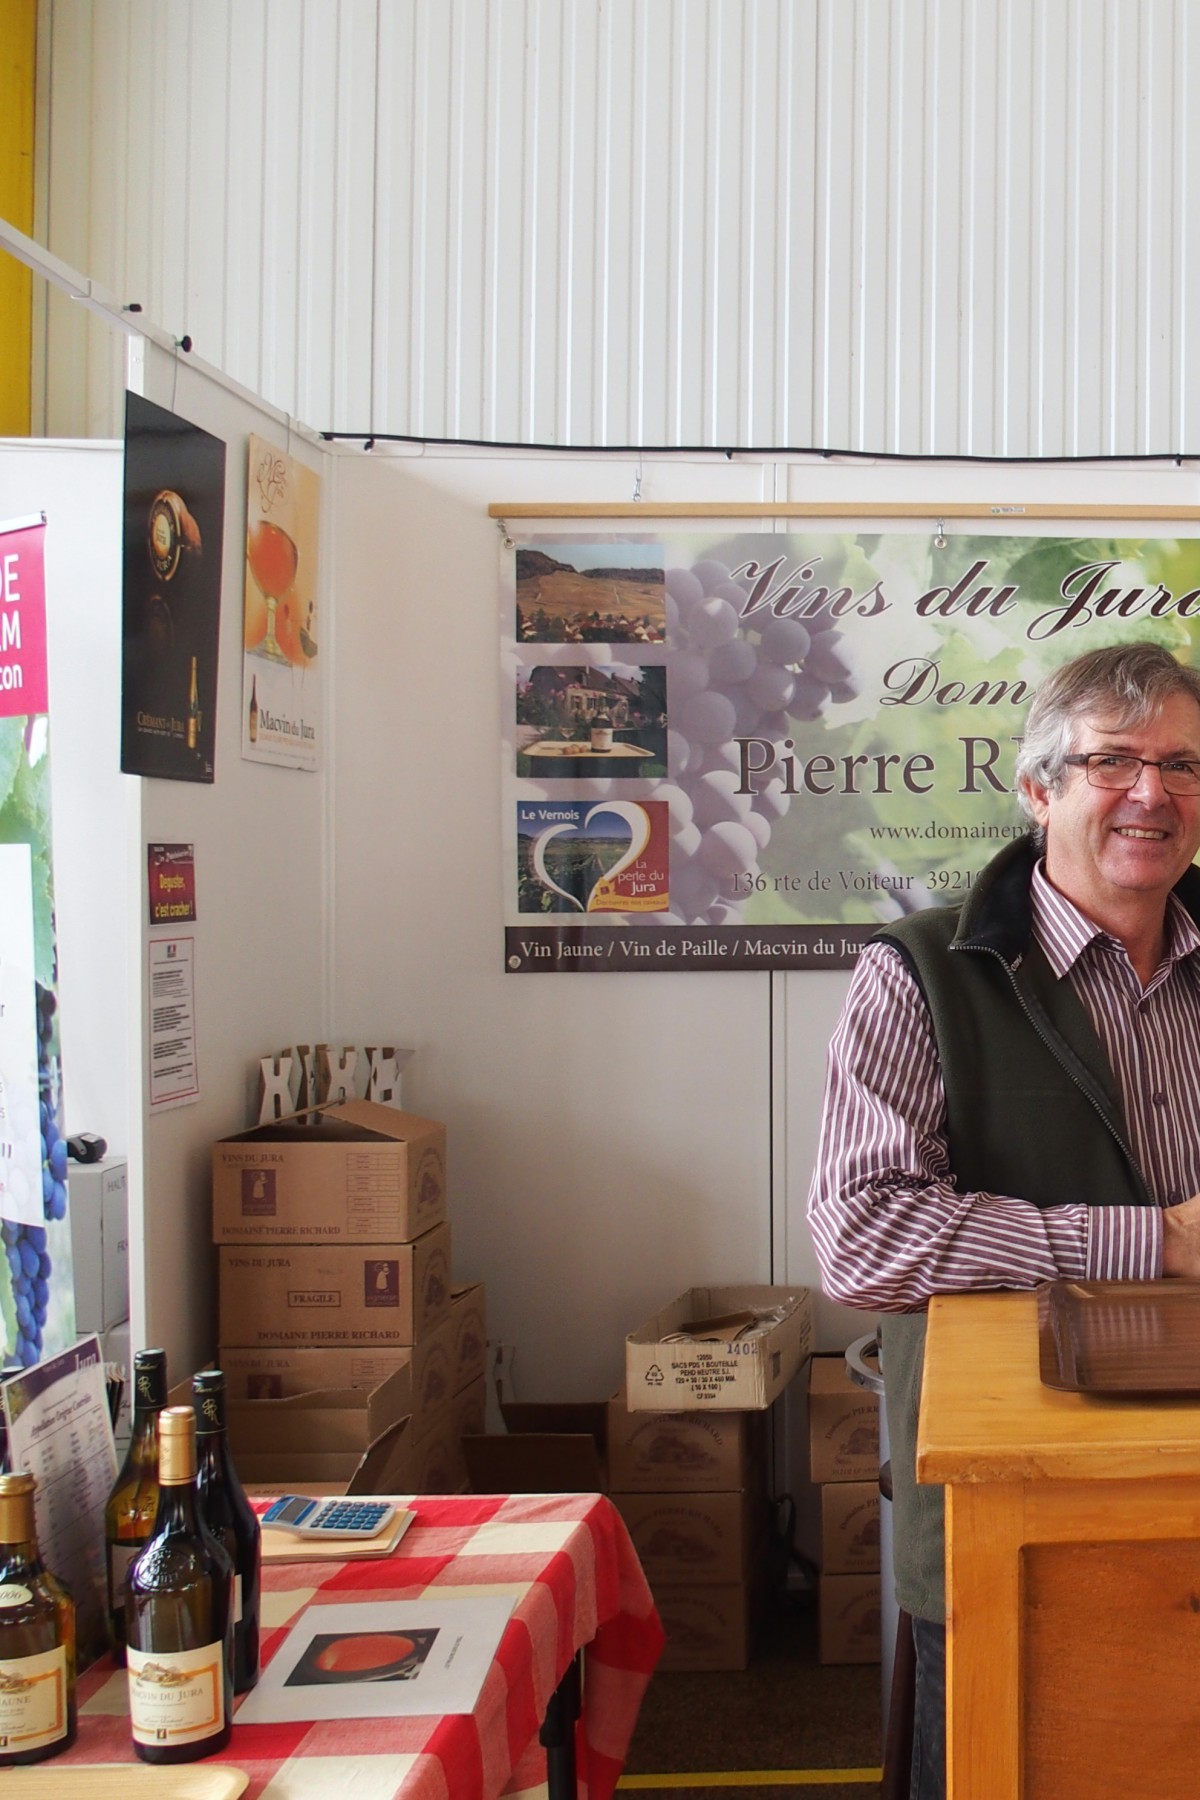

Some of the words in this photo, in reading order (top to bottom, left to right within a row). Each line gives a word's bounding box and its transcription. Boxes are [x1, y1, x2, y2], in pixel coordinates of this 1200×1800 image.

[0, 553, 20, 602] E
[730, 555, 894, 618] Vins
[914, 559, 1020, 618] du
[0, 610, 21, 651] M
[879, 657, 1036, 707] Dom
[259, 708, 290, 732] Macvin
[300, 719, 315, 740] Jura
[732, 736, 935, 795] Pierre
[521, 810, 535, 820] Le
[538, 810, 580, 820] Vernois
[869, 821, 1027, 840] www.domainep
[636, 860, 647, 869] La
[617, 871, 646, 884] perle
[649, 870, 664, 881] du
[731, 872, 767, 893] 136
[774, 874, 801, 892] rte
[808, 871, 831, 891] de
[839, 871, 915, 891] Voiteur
[631, 882, 656, 896] Jura
[520, 941, 552, 957] Vin
[557, 941, 603, 960] Jaune
[619, 940, 650, 956] Vin
[656, 940, 676, 956] de
[681, 939, 728, 956] Paille
[744, 939, 808, 955] Macvin
[813, 939, 837, 955] du
[840, 939, 866, 958] Jur
[260, 1154, 284, 1163] JURA
[266, 1227, 299, 1235] PIERRE
[300, 1227, 341, 1235] RICHARD
[266, 1259, 291, 1267] JURA
[293, 1294, 336, 1303] FRAGILE
[258, 1331, 306, 1340] DOMAINE
[310, 1331, 349, 1340] PIERRE
[352, 1331, 400, 1340] RICHARD
[727, 1343, 758, 1355] 1402
[706, 1360, 738, 1368] BOUTEILLE
[178, 1687, 204, 1701] JURA
